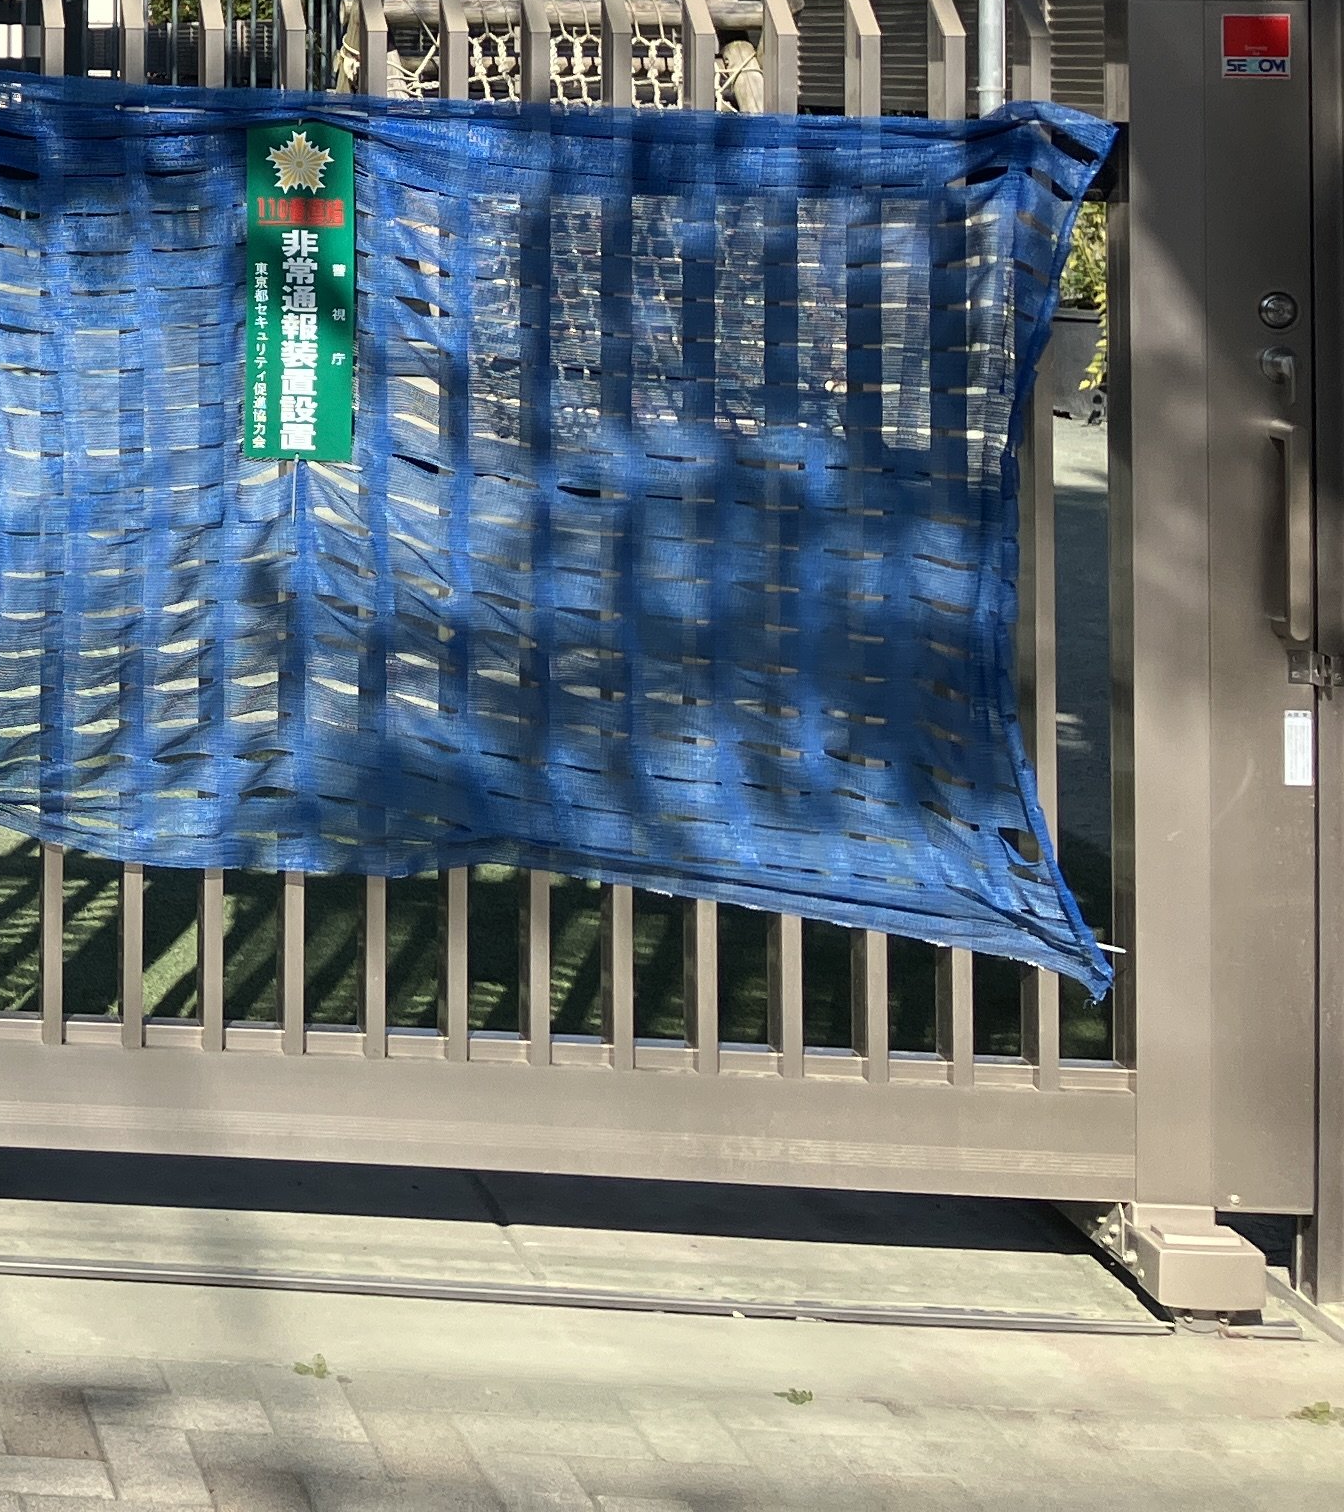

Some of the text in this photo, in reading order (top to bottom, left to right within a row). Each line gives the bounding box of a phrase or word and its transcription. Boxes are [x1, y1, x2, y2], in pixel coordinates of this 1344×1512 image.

[1226, 58, 1287, 73] SECOM
[252, 262, 269, 449] 東京都セキュリティ促進協力会
[279, 229, 319, 451] 非常通報装置設置
[331, 263, 347, 366] 警視庁
